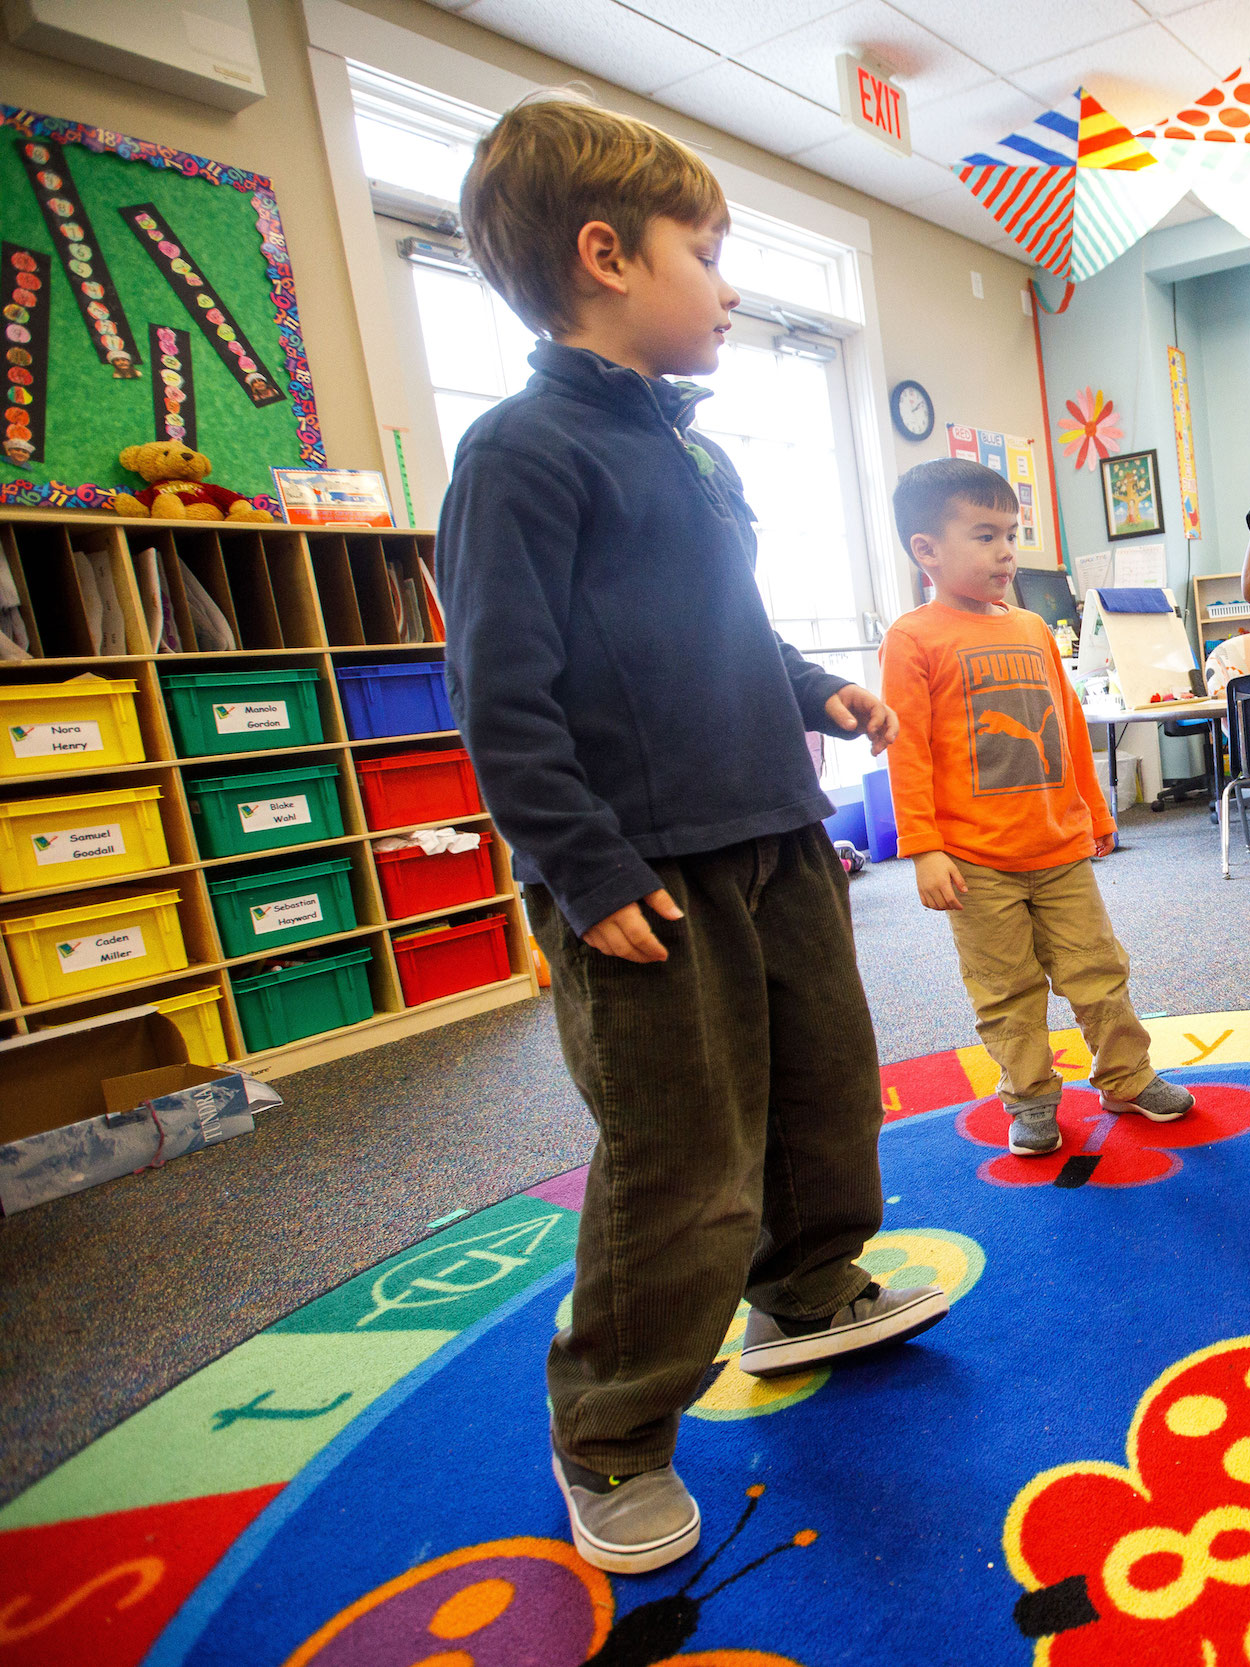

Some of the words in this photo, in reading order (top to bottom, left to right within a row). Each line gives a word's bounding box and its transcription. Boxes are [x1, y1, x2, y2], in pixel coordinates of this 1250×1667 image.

[857, 66, 901, 141] EXIT
[955, 427, 971, 440] RED
[970, 653, 1046, 686] PUMA
[244, 704, 278, 714] Manolo
[51, 726, 81, 735] Nora
[247, 720, 280, 729] Gordon
[52, 742, 88, 751] Henry
[269, 801, 294, 811] Blake
[273, 813, 296, 823] Wahl
[69, 829, 111, 843] Samuel
[72, 845, 114, 859] Goodall
[273, 898, 317, 913] Sebastian
[278, 910, 318, 926] Hayward
[95, 934, 129, 947] Caden
[100, 949, 132, 962] Miller
[1181, 1029, 1235, 1066] y
[193, 1087, 223, 1143] TUNDRA
